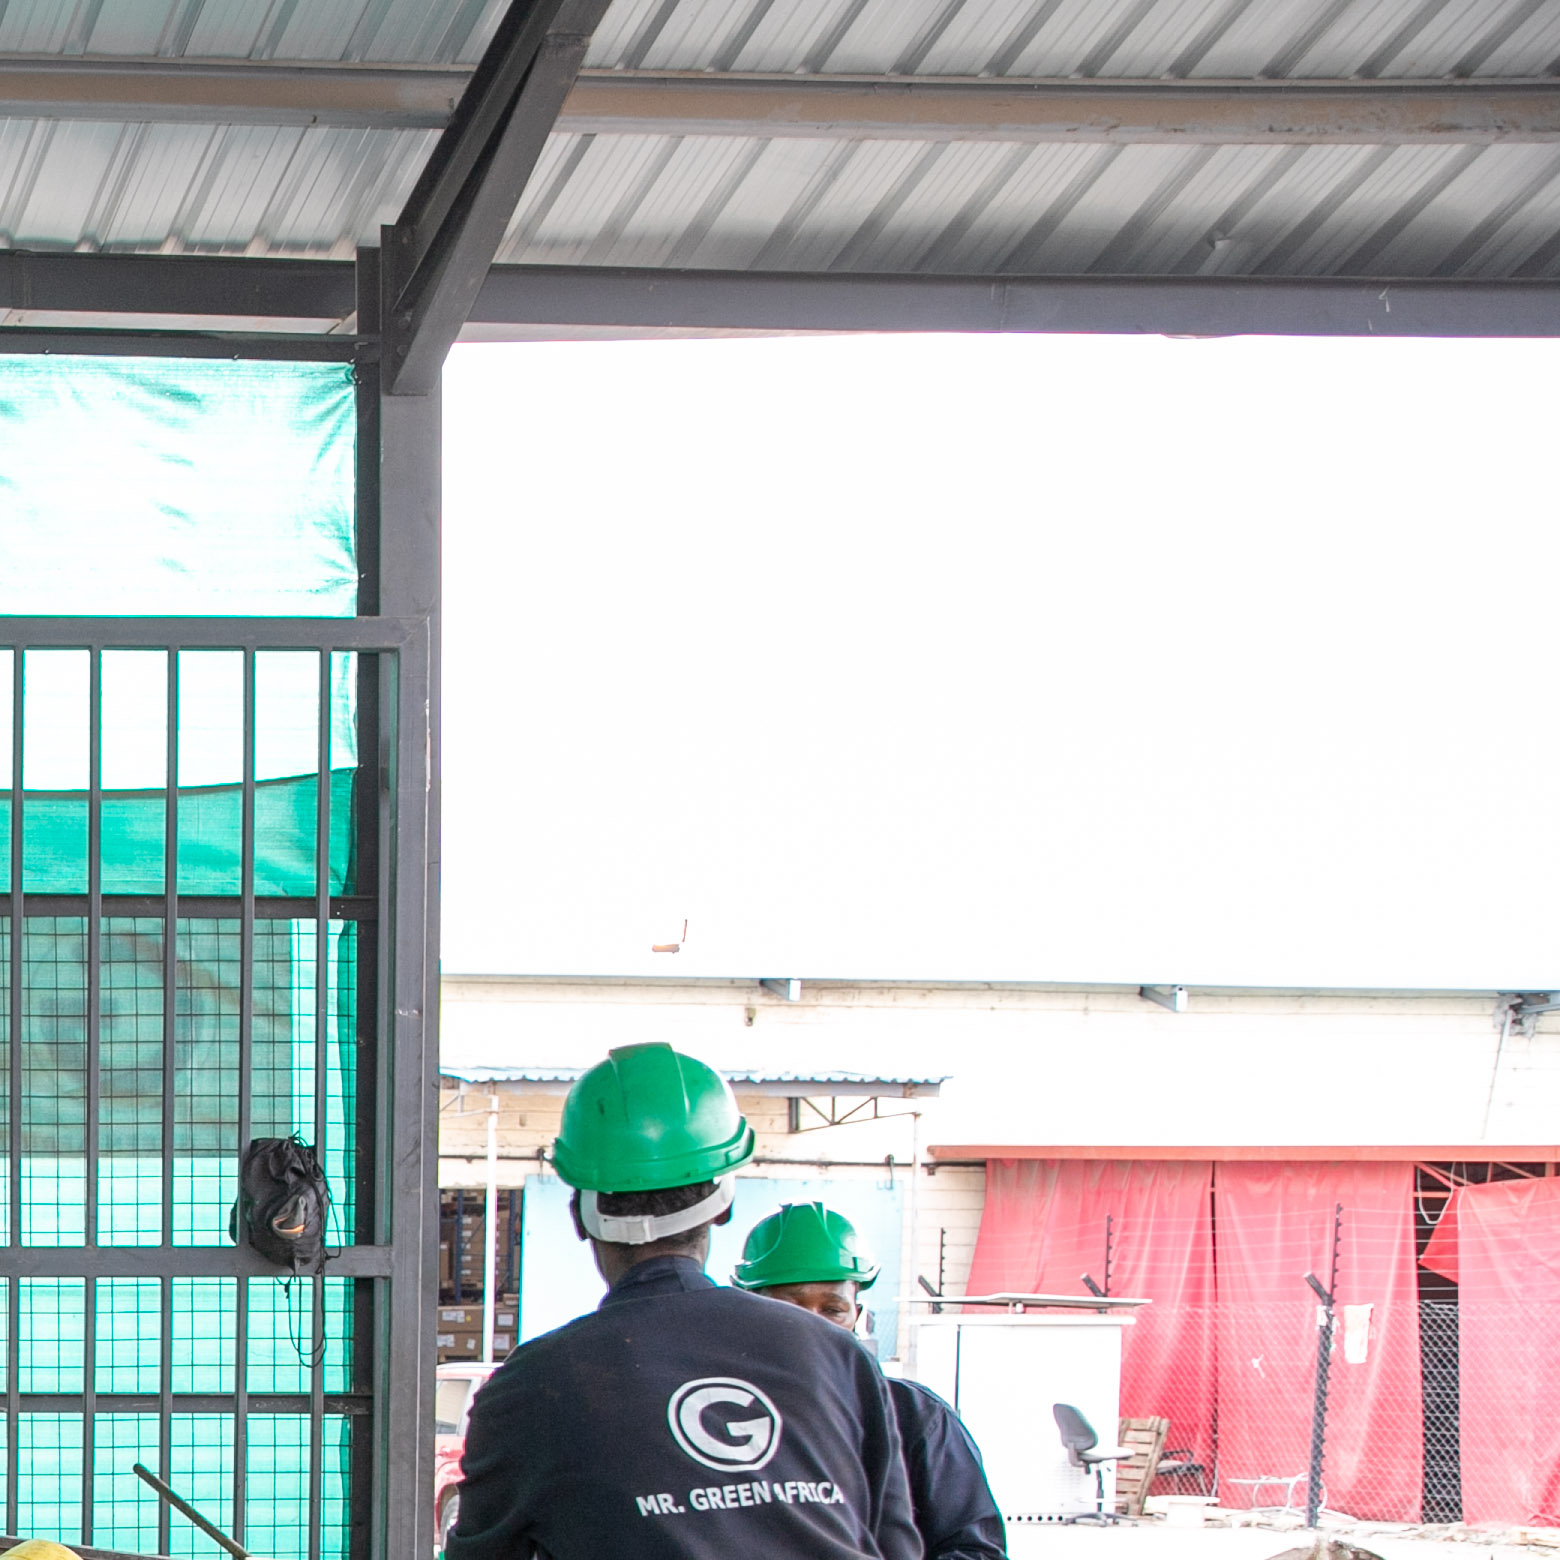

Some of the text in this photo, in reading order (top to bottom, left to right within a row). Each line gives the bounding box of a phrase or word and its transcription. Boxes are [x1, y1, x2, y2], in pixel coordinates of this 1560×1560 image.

[679, 1386, 772, 1462] G
[635, 1481, 844, 1516] MR. GREEN AFRICA
